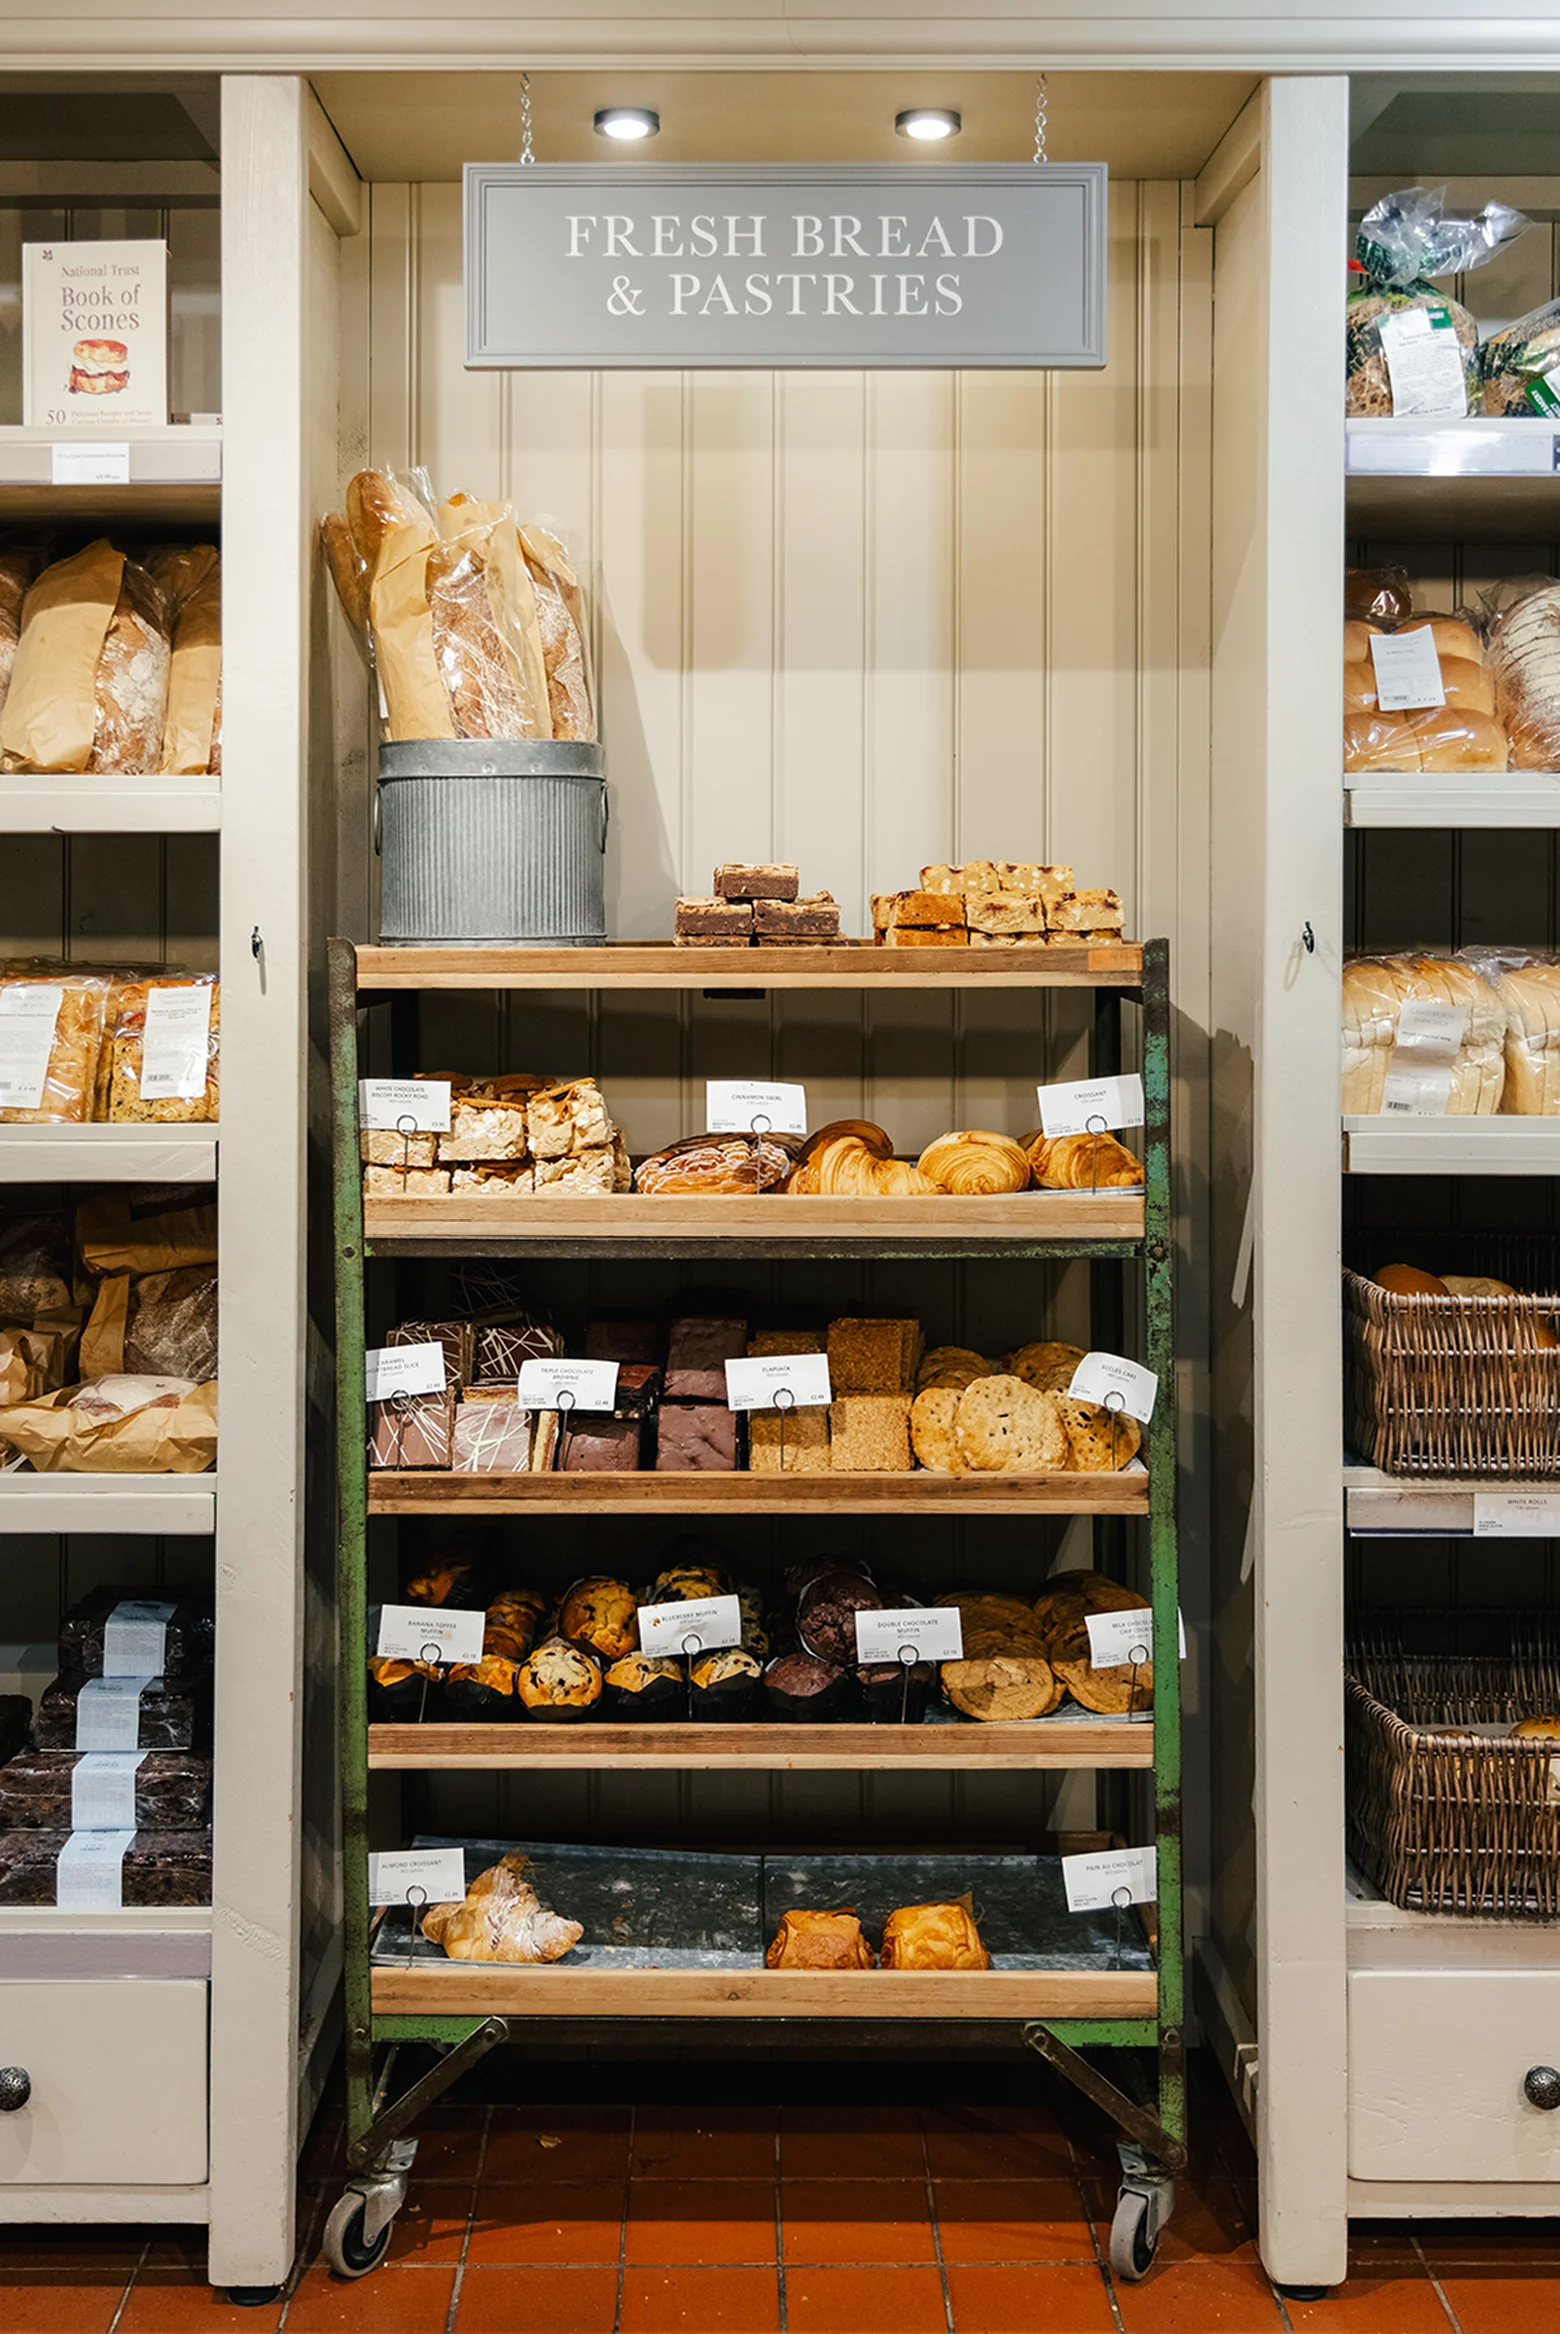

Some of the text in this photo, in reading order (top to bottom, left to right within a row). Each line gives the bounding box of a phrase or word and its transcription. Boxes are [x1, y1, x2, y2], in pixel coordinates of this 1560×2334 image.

[565, 215, 1005, 258] FRESH BREAD
[61, 264, 140, 278] National Trust
[61, 284, 141, 307] Book of
[605, 273, 964, 317] & PASTRIES
[60, 309, 141, 332] Scones
[45, 408, 67, 426] 50
[1074, 1090, 1108, 1100] CROISSANT
